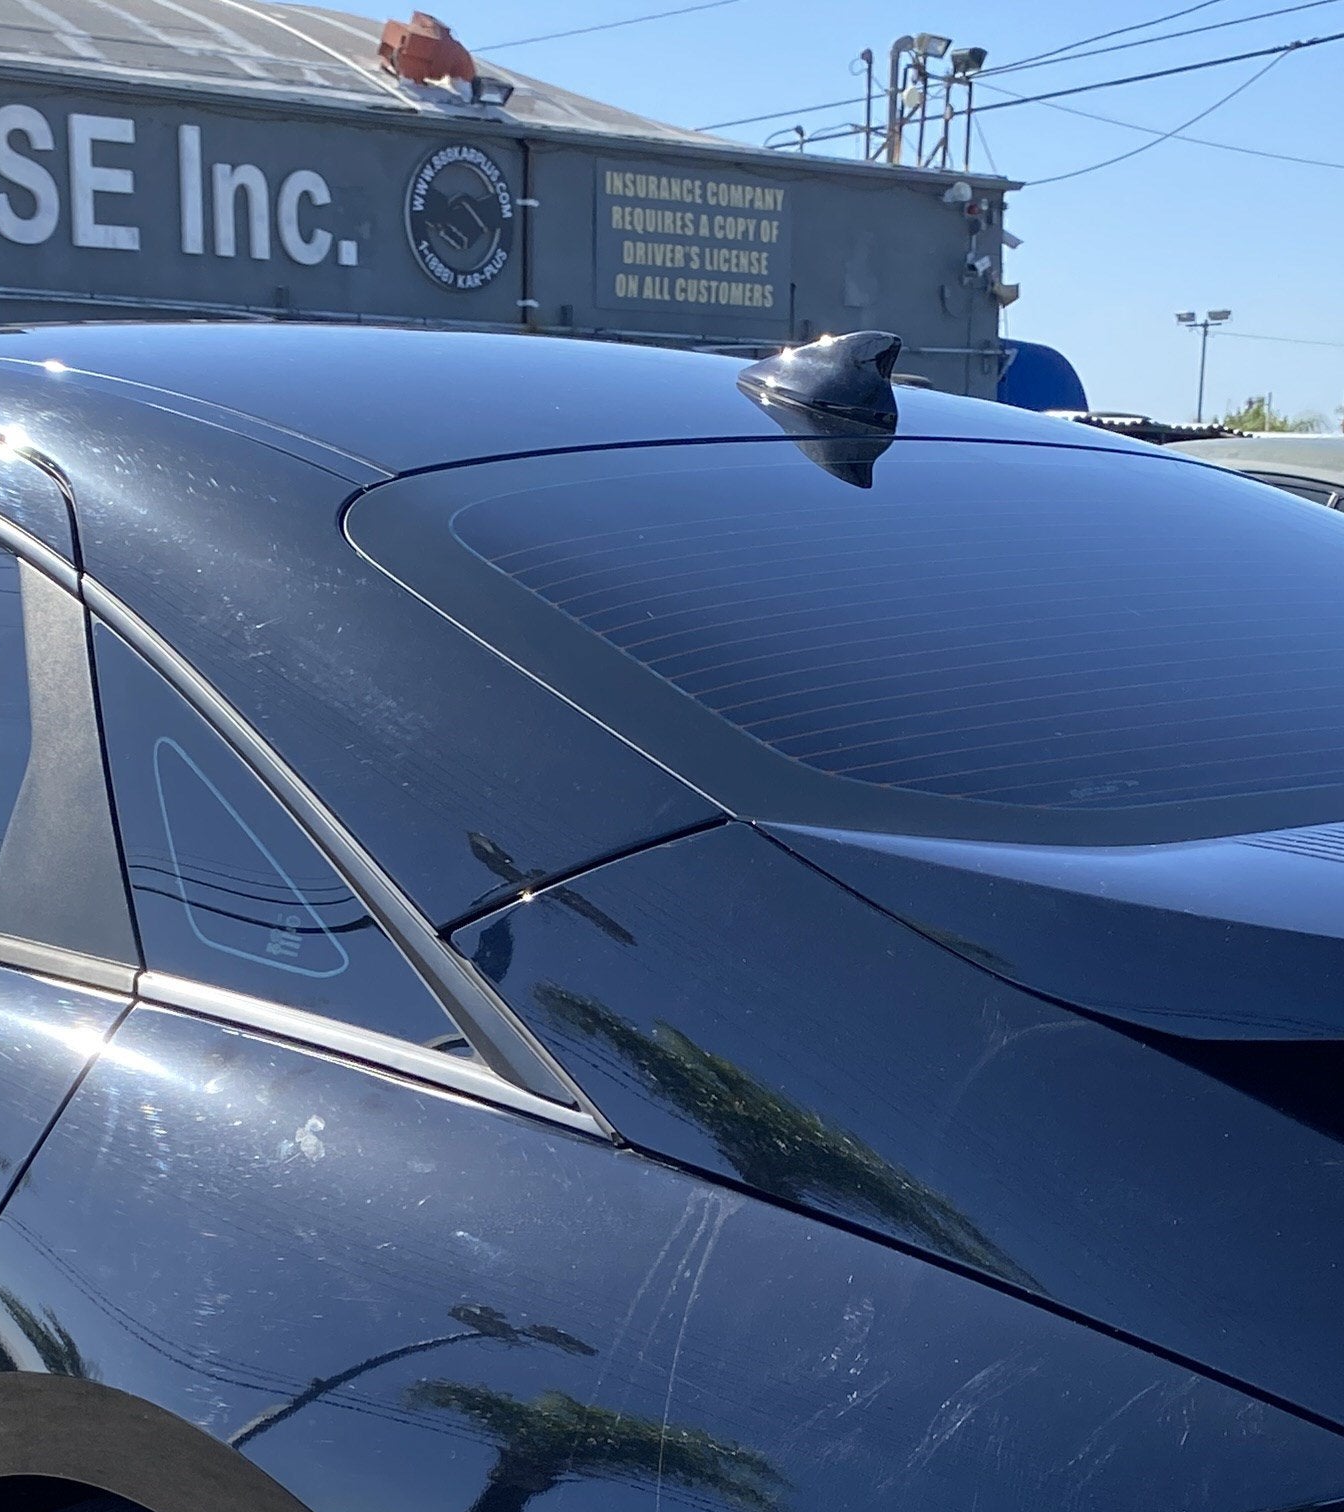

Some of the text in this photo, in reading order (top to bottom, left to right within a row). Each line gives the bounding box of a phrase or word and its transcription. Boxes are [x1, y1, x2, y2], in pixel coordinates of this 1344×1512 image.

[177, 123, 359, 267] Inc.
[605, 171, 785, 212] INSURANCE COMPANY
[611, 205, 779, 243] REQUIRES A COPY OF
[623, 240, 769, 275] DRIVER'S LICENSE
[615, 273, 774, 307] ON ALL CUSTOMERS
